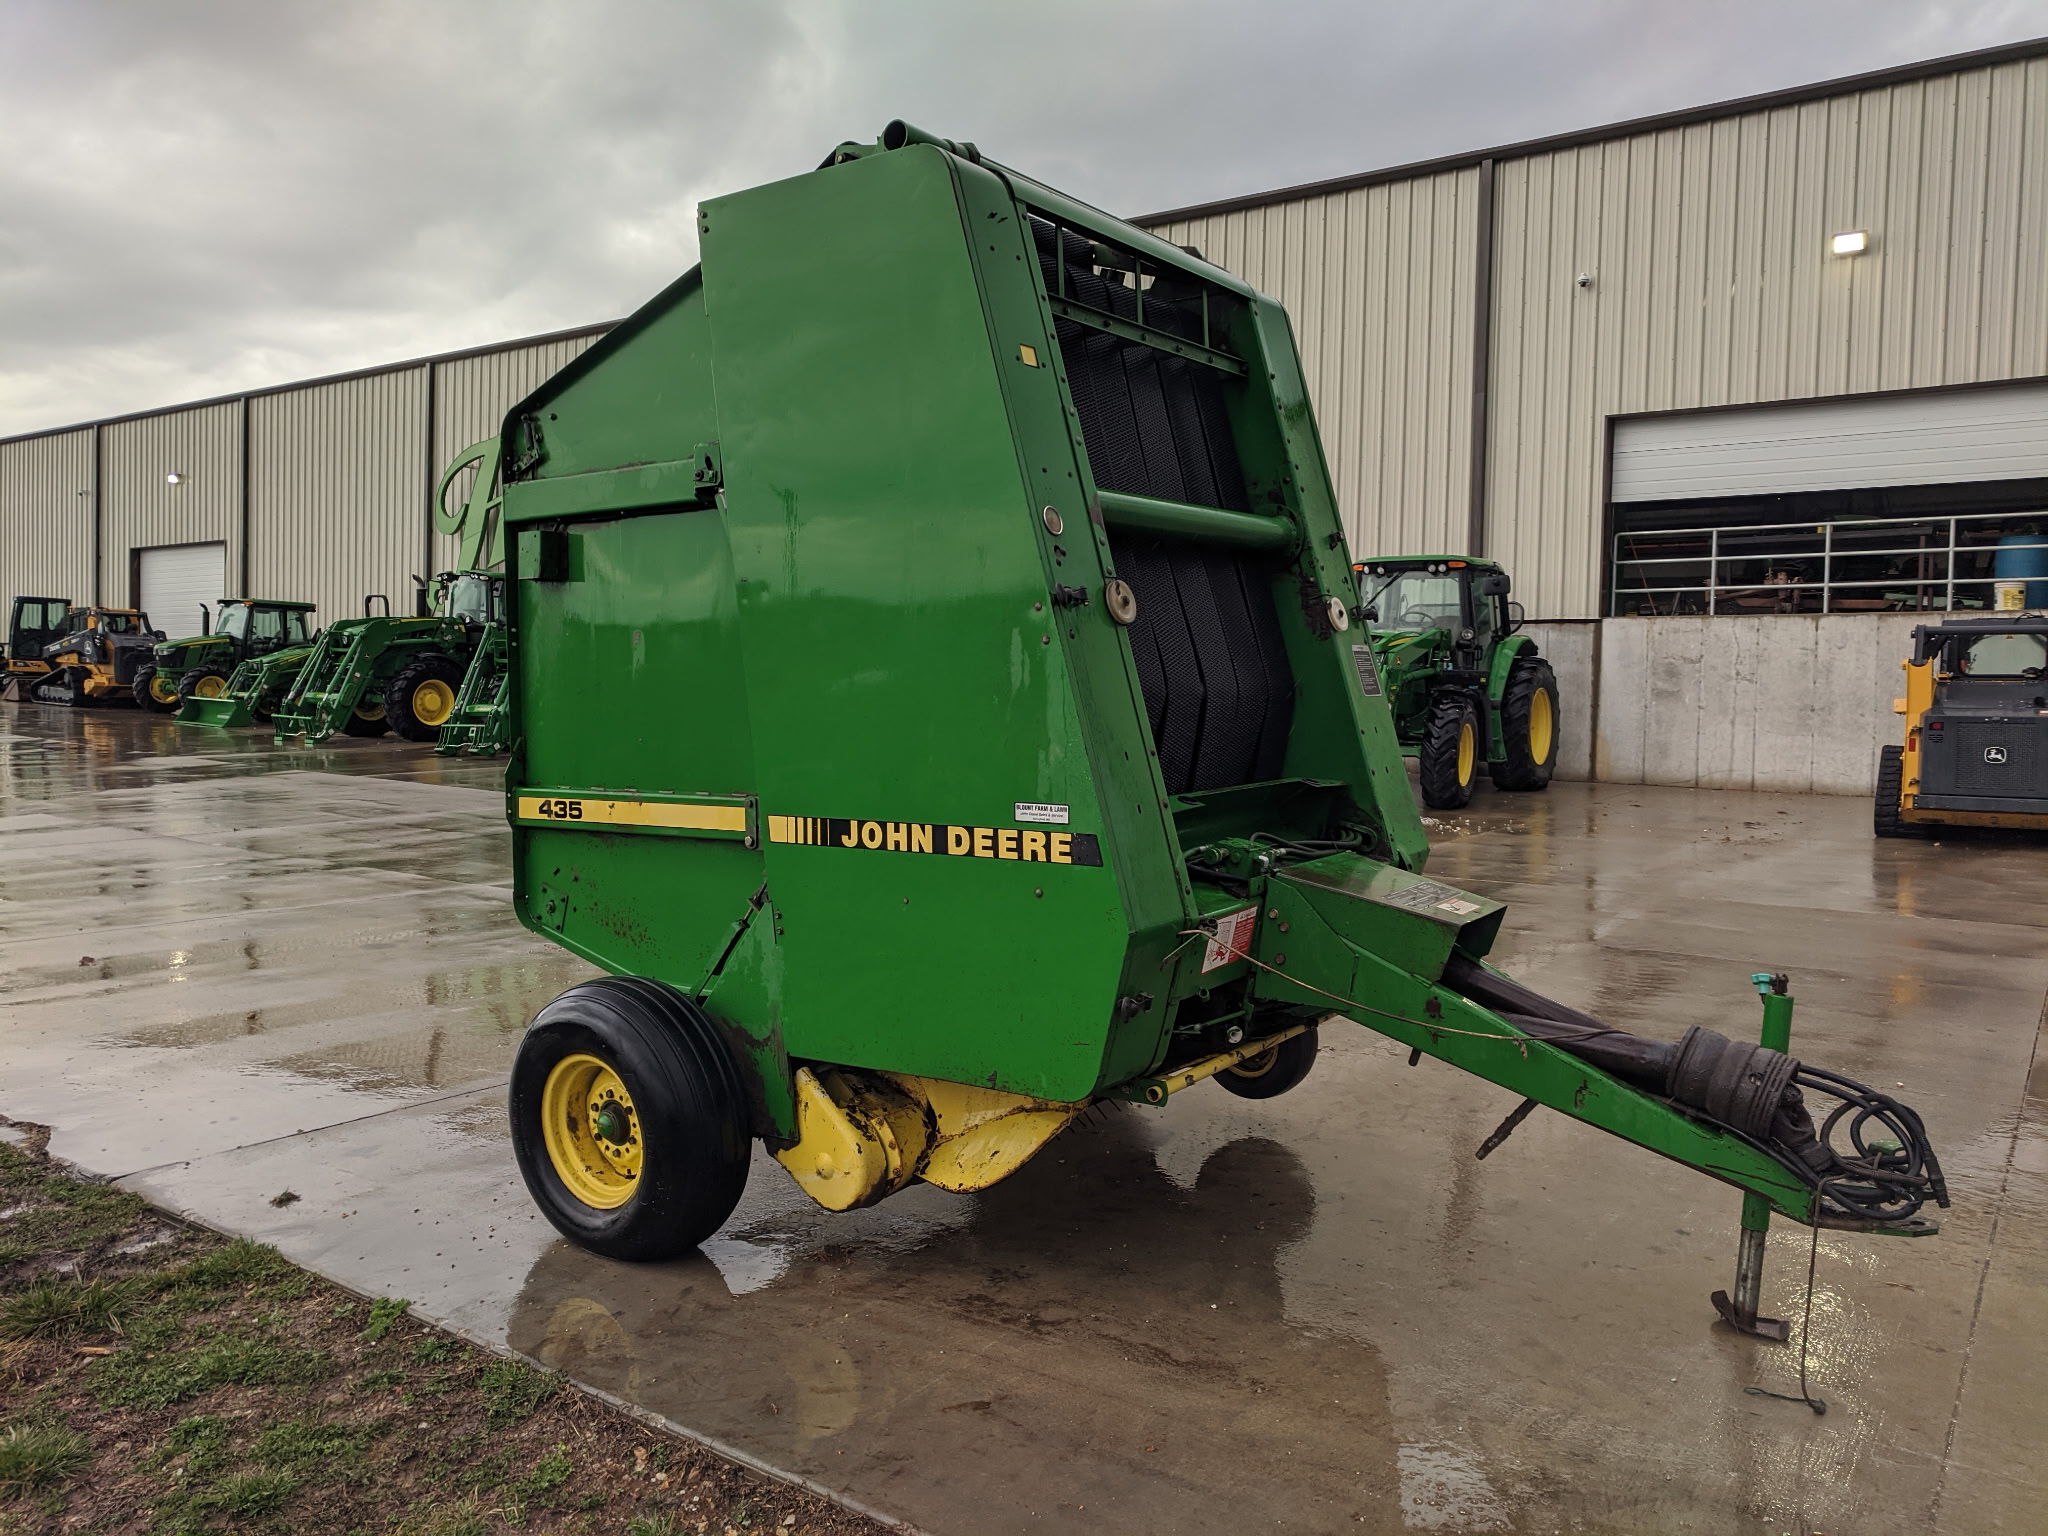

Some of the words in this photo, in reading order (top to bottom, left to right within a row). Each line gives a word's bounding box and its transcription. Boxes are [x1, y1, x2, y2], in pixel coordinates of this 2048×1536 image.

[539, 800, 582, 819] 435
[841, 820, 932, 853] JOHN
[947, 825, 1072, 864] DEERE
